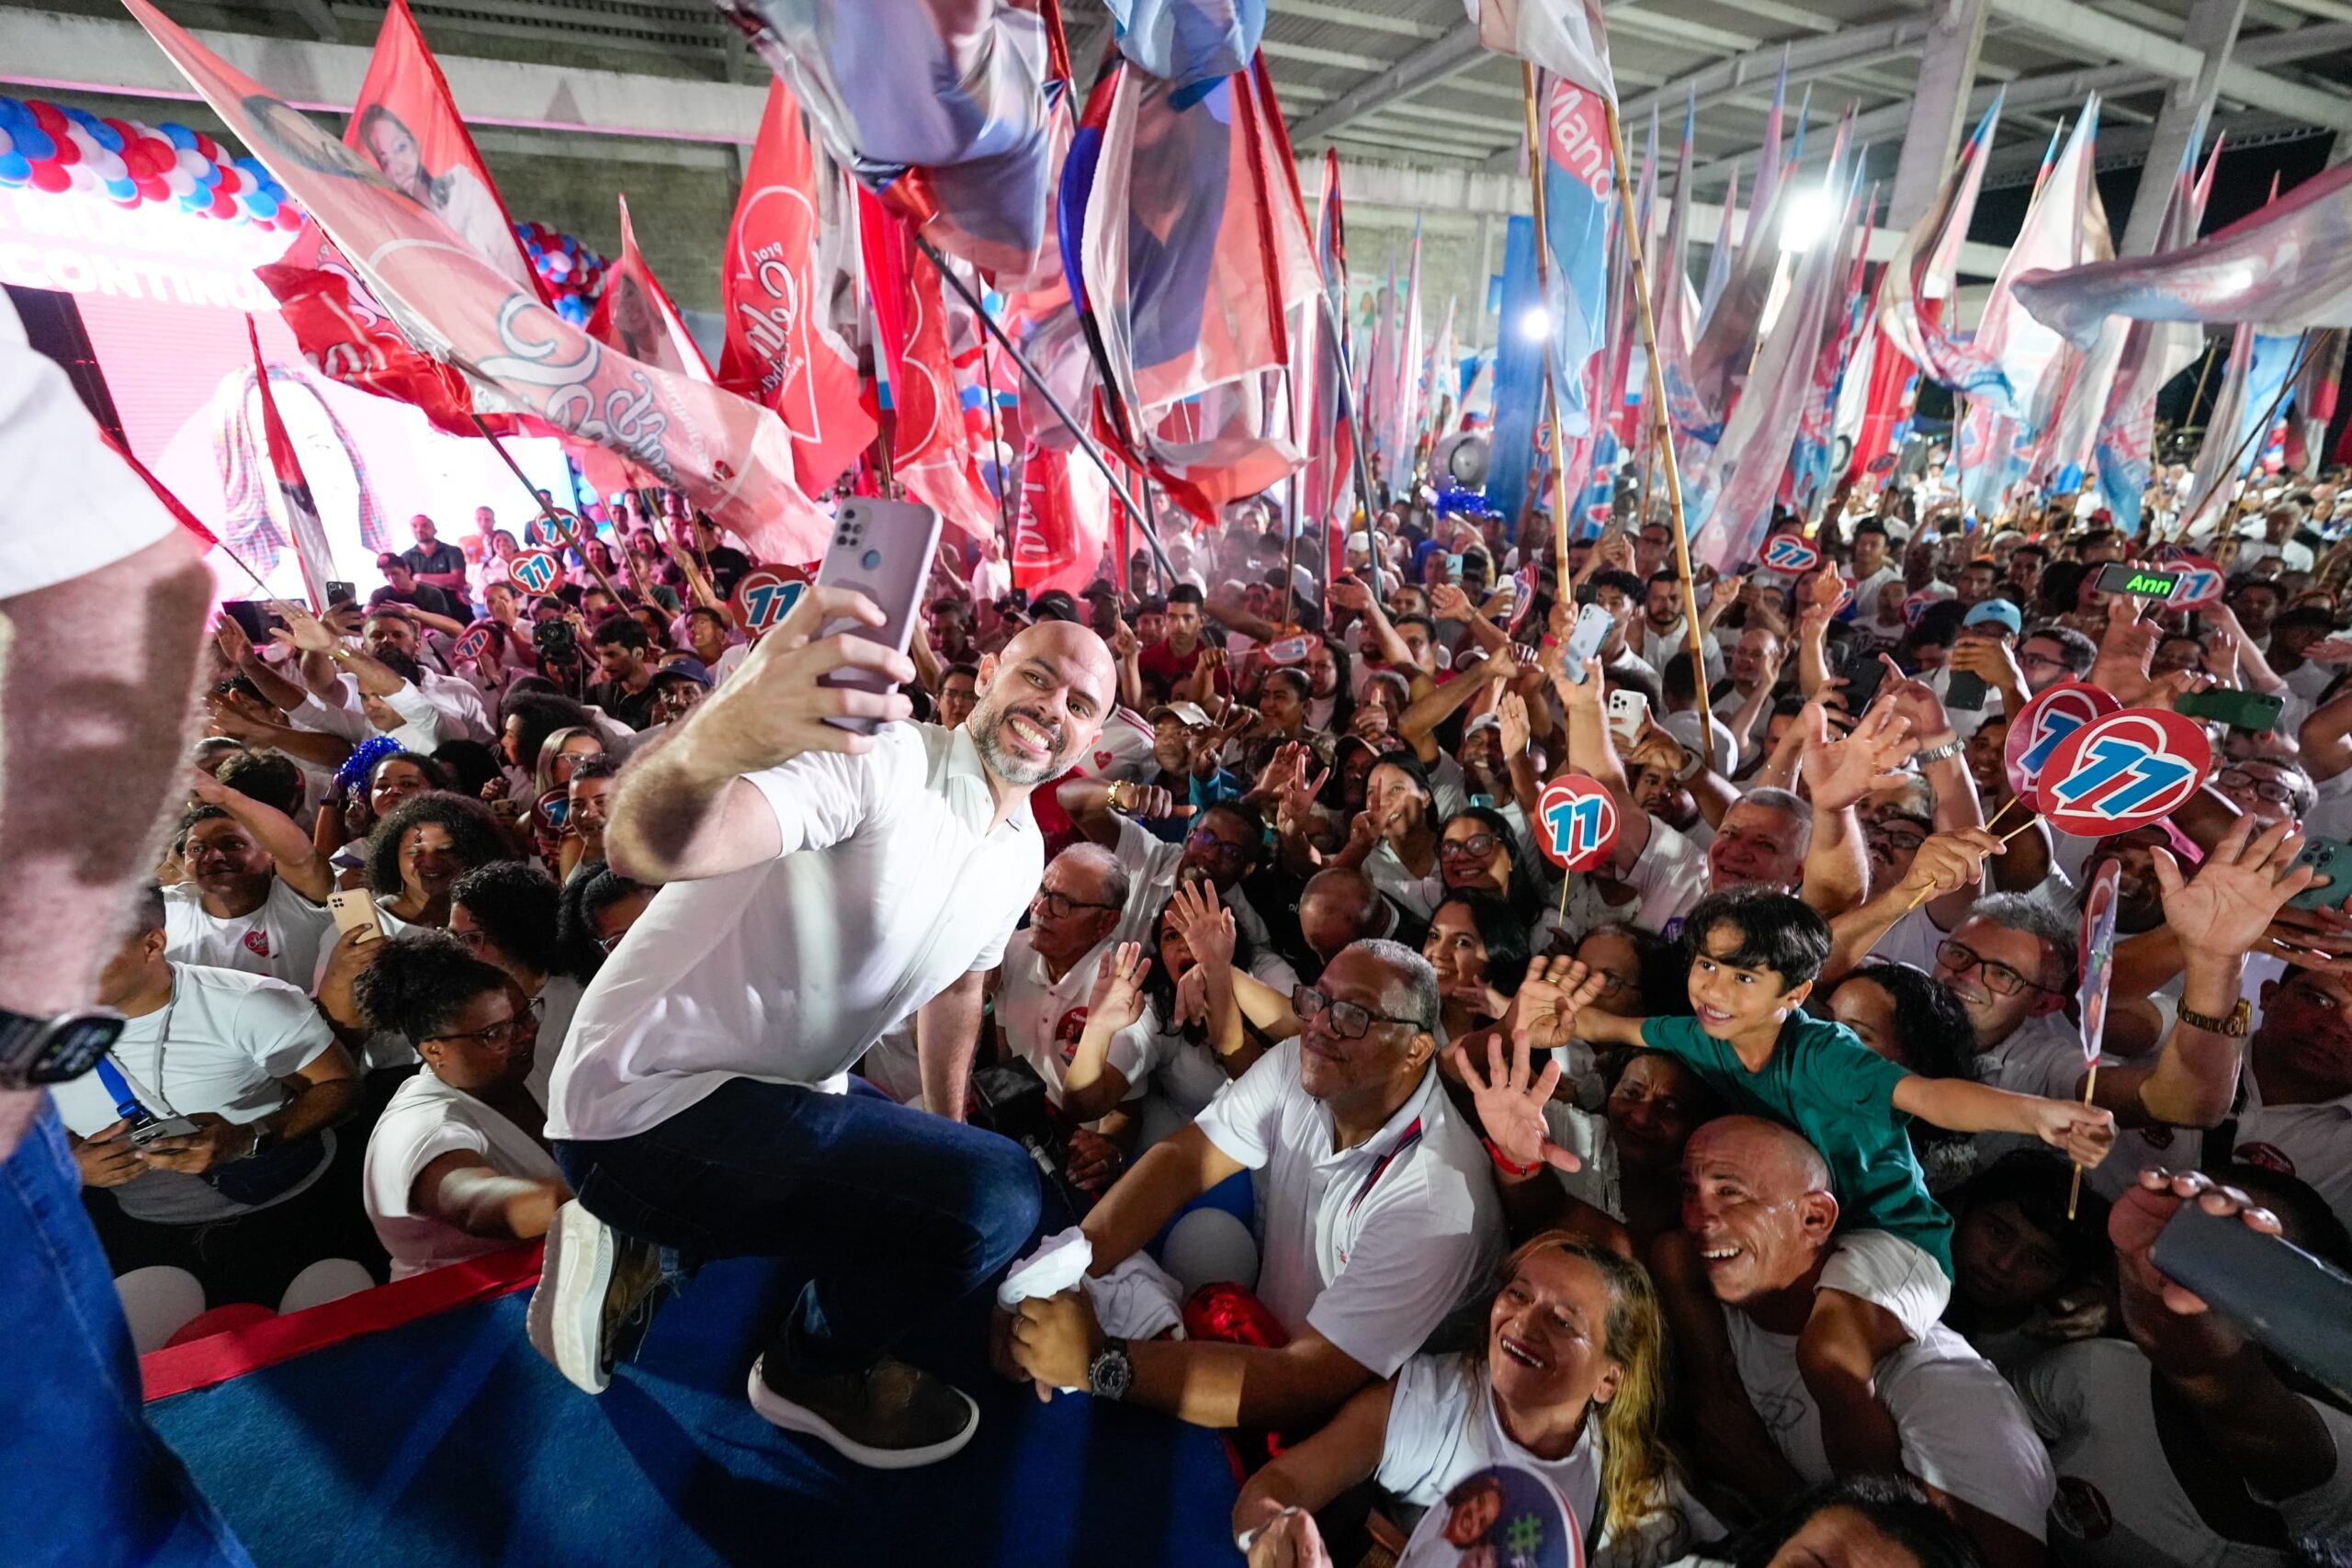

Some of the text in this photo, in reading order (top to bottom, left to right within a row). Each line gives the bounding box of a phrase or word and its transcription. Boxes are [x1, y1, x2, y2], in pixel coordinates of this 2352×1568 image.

[1766, 540, 1815, 567] 11
[516, 554, 553, 591] 11
[2125, 573, 2172, 595] Ann
[746, 581, 805, 626] 11
[458, 631, 485, 657] 11
[2052, 737, 2197, 818] 11
[1546, 796, 1603, 855] 11
